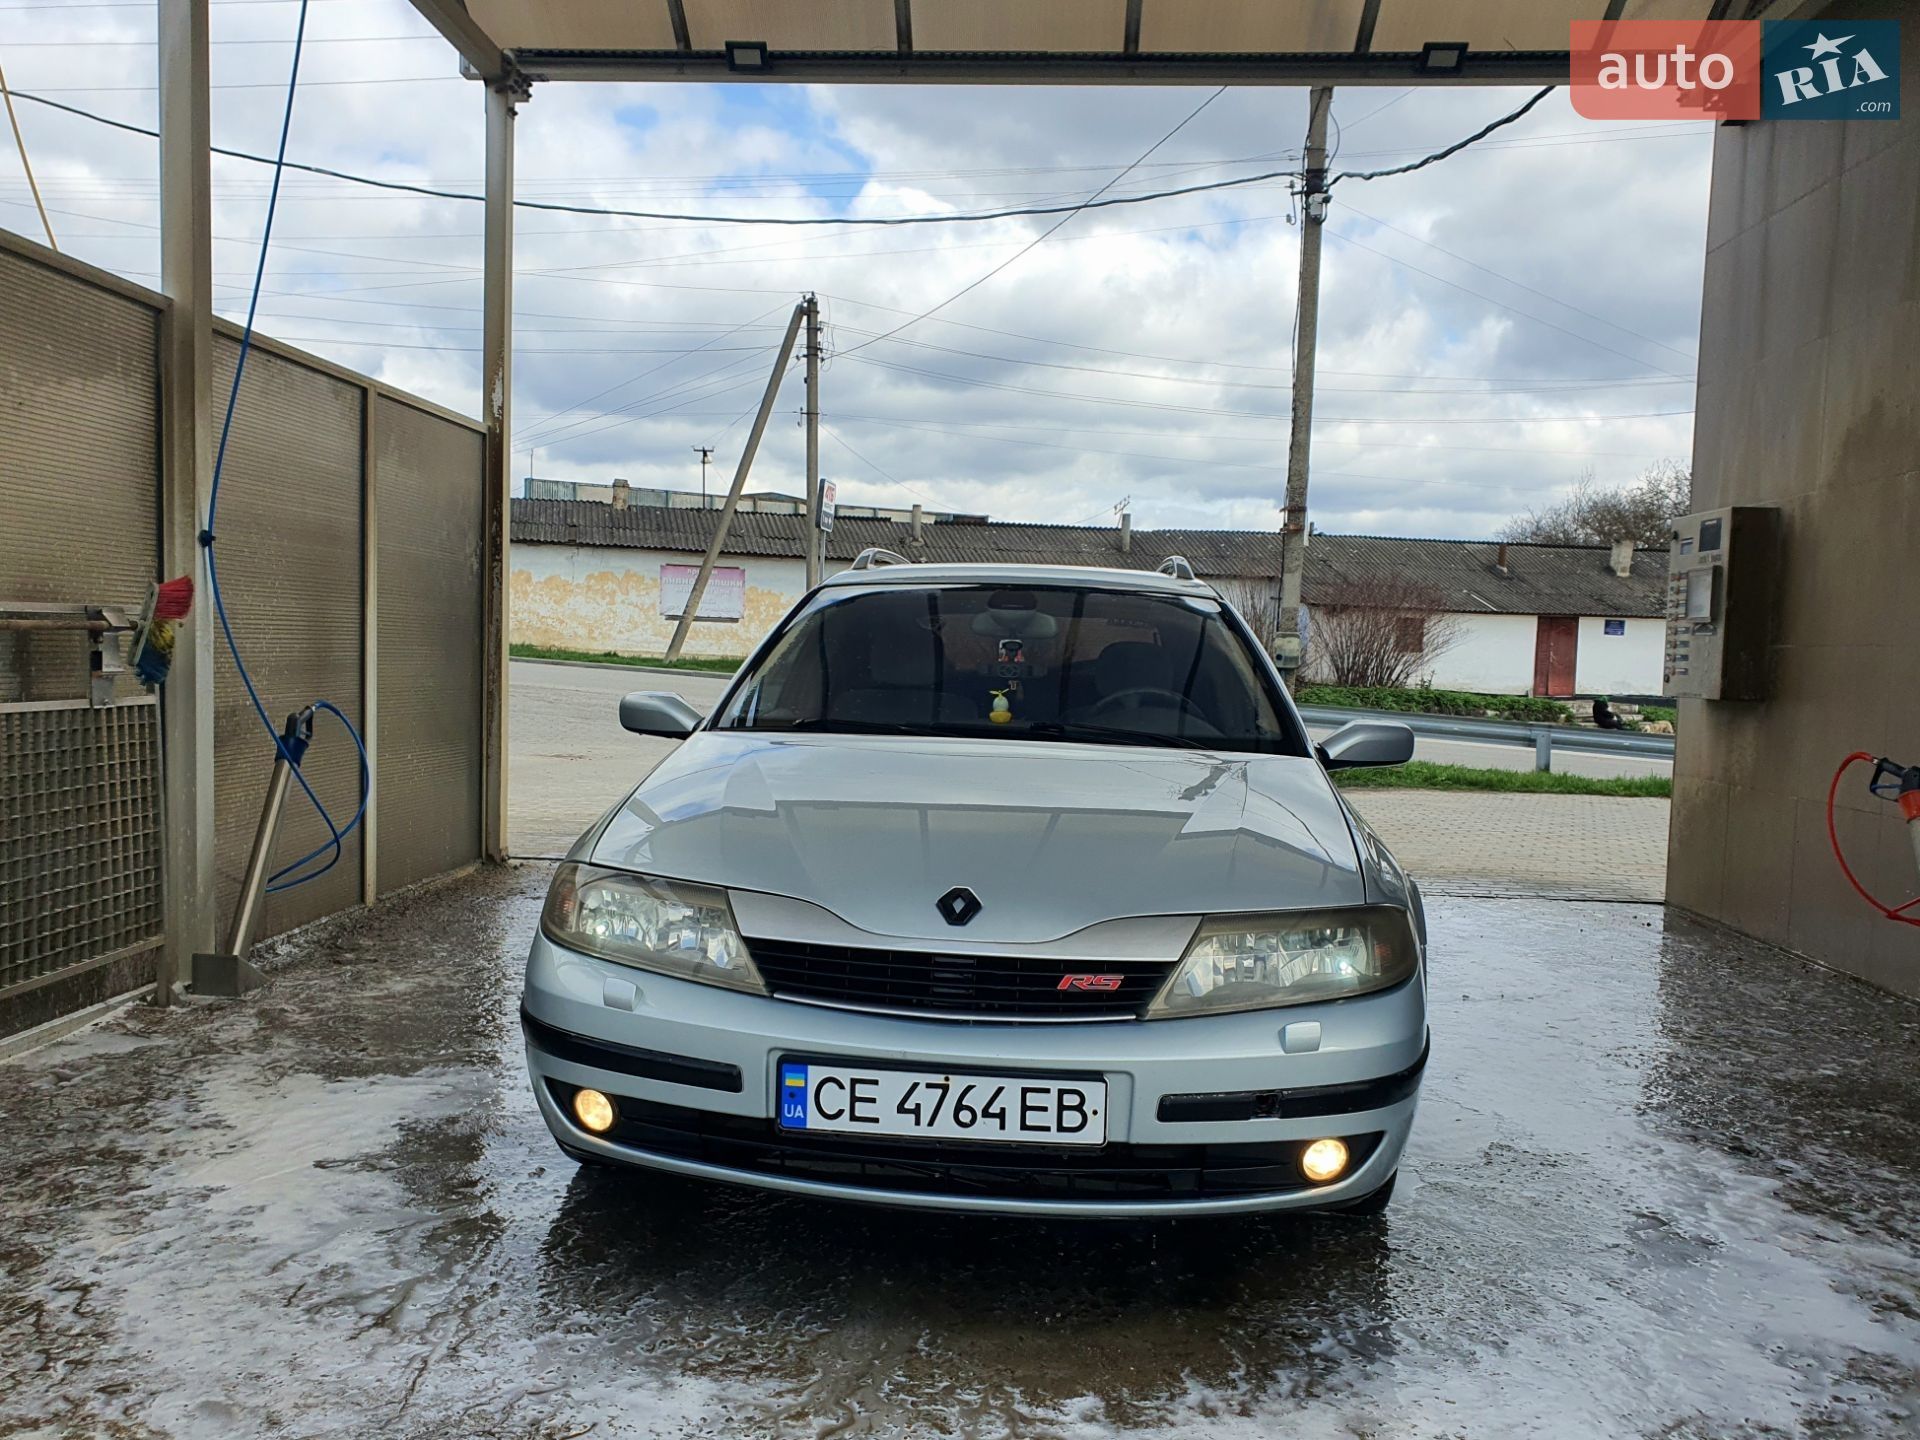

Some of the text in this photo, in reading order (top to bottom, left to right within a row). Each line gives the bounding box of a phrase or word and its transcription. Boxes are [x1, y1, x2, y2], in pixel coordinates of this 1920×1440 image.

[1057, 974, 1124, 991] RS
[784, 1103, 804, 1119] UA
[814, 1076, 1088, 1133] CE 4764 EB
